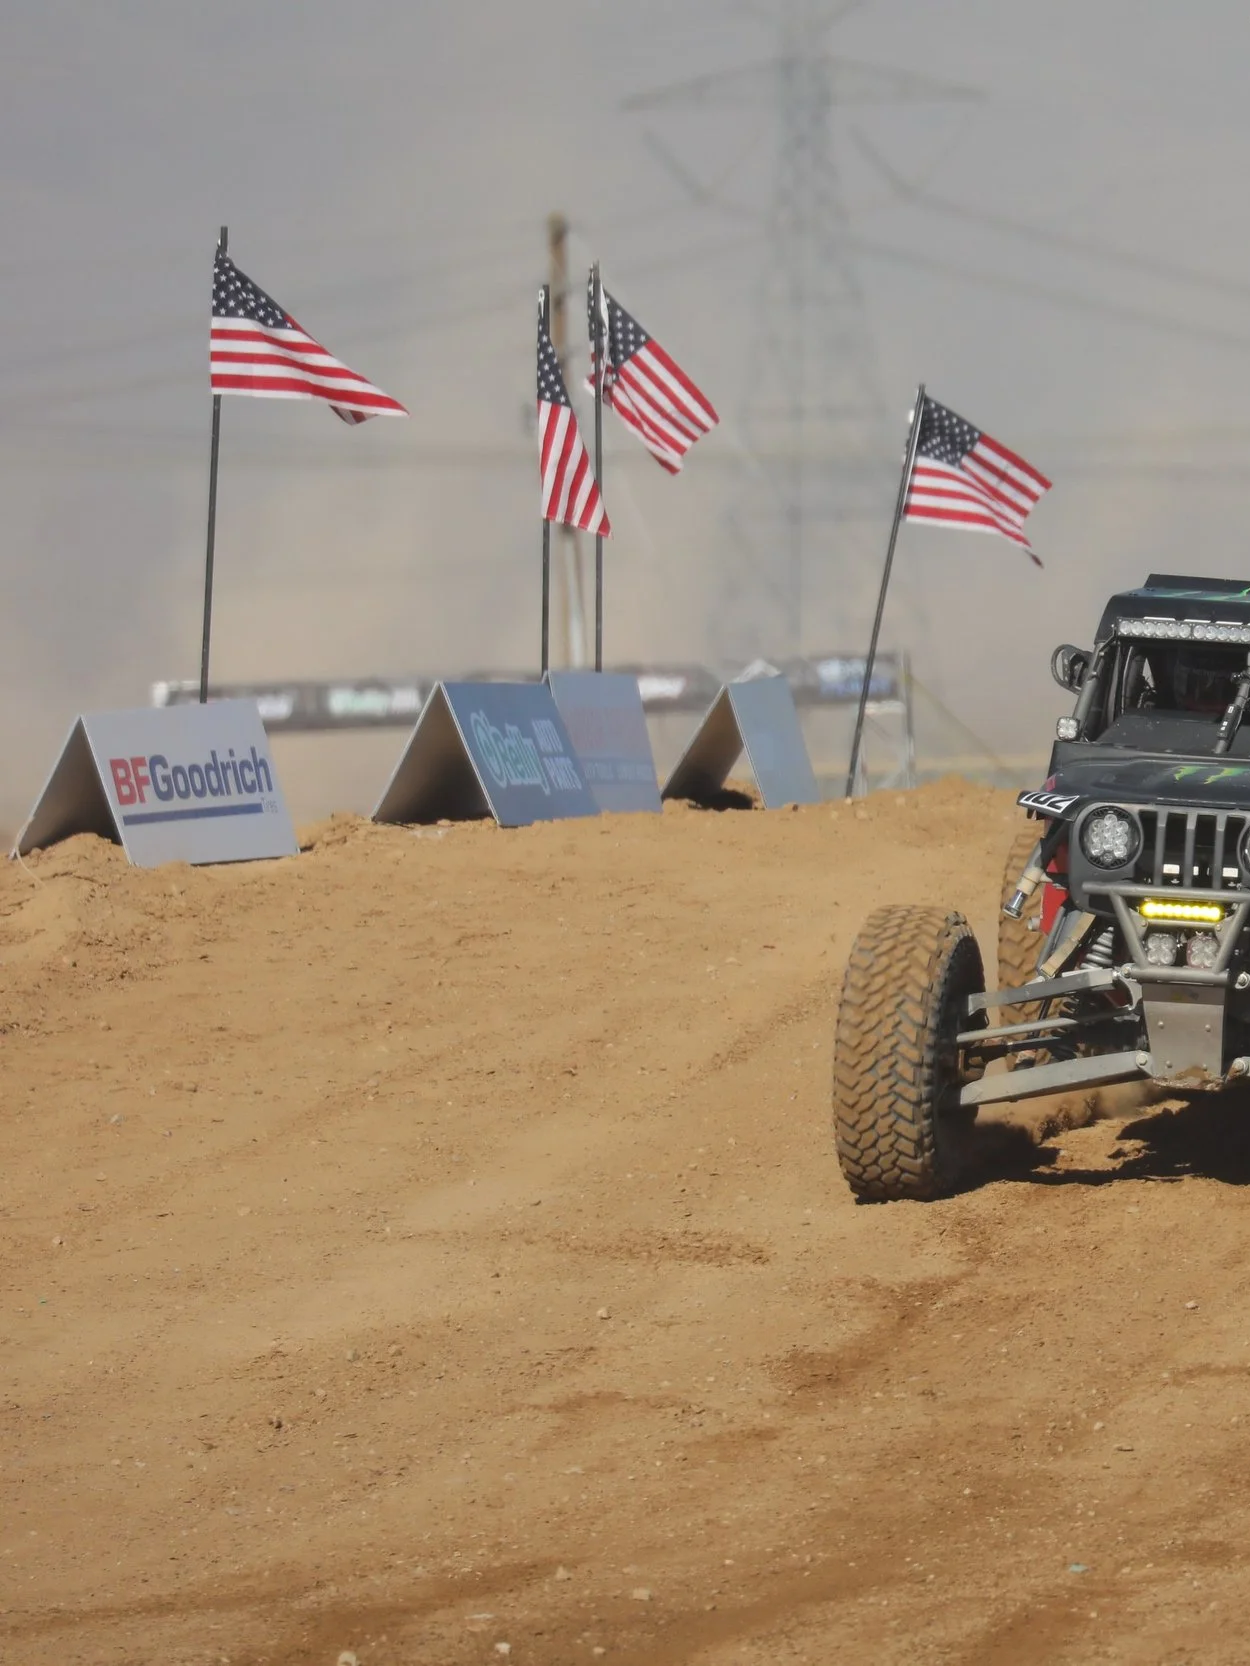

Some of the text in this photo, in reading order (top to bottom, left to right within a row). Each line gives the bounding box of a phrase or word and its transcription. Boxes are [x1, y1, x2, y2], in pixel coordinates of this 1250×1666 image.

[109, 746, 273, 806] BFGoodrich
[542, 756, 583, 791] PARTS
[1023, 792, 1079, 811] 102
